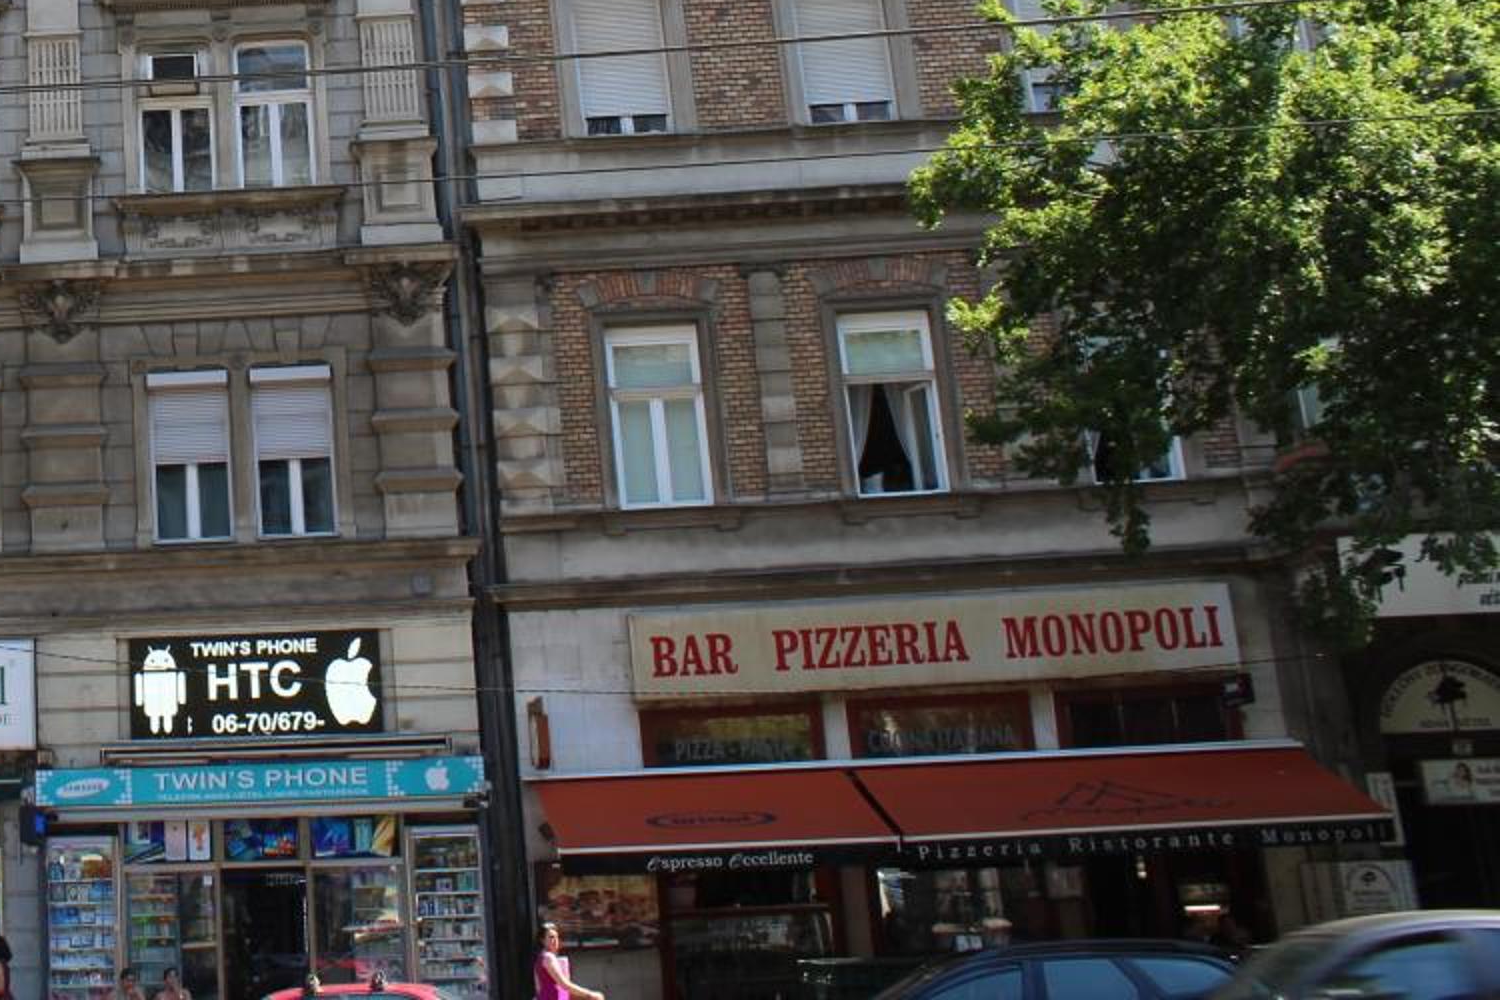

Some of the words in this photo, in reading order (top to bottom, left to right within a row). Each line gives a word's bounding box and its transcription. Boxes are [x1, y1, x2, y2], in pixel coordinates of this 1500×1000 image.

[190, 639, 251, 658] TWIN'S
[257, 637, 318, 655] PHONE
[649, 632, 739, 678] BAR
[772, 619, 971, 672] PIZZERIA
[1001, 605, 1224, 659] MONOPOLI
[207, 660, 302, 701] HTC
[211, 711, 326, 735] 06-70/679-
[154, 770, 255, 791] TWIN'S
[265, 766, 368, 787] PHONE
[918, 840, 1041, 860] Pizzeria
[1068, 831, 1234, 854] Ristorante
